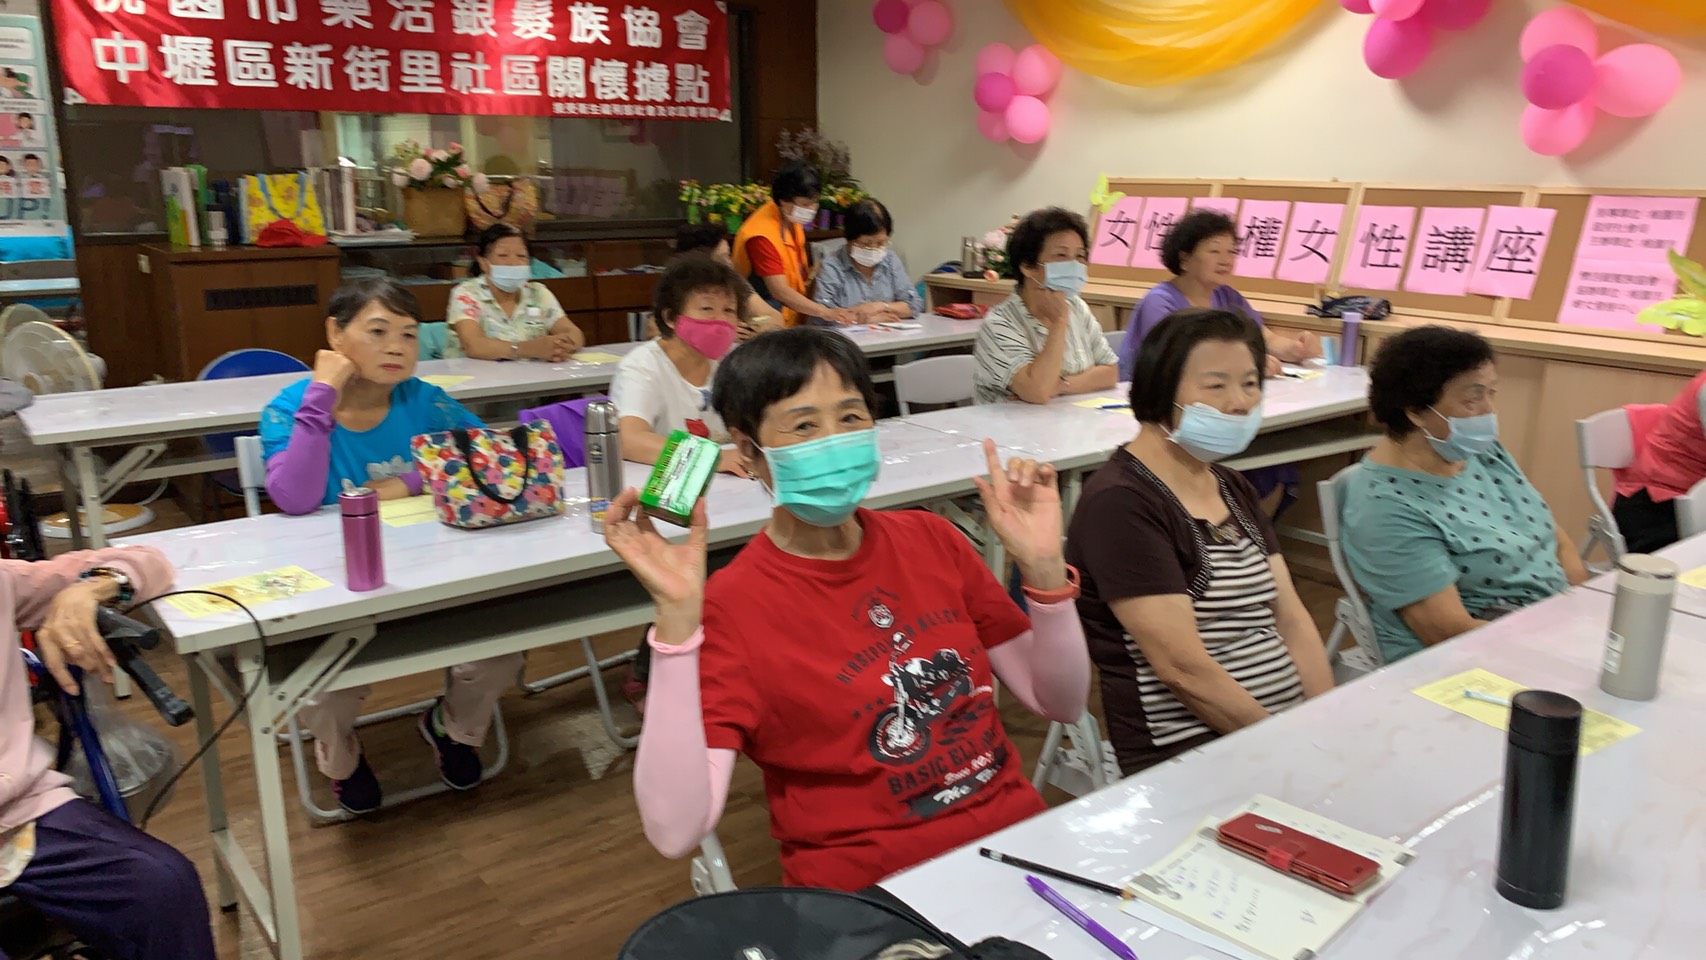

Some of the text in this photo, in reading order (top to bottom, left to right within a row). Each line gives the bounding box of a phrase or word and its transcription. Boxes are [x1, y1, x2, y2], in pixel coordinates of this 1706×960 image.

[92, 0, 711, 51] 市樂活銀髮族協會
[91, 30, 711, 105] 中壢區新街里社區關懷據點
[1099, 209, 1544, 276] 女性權女性講座
